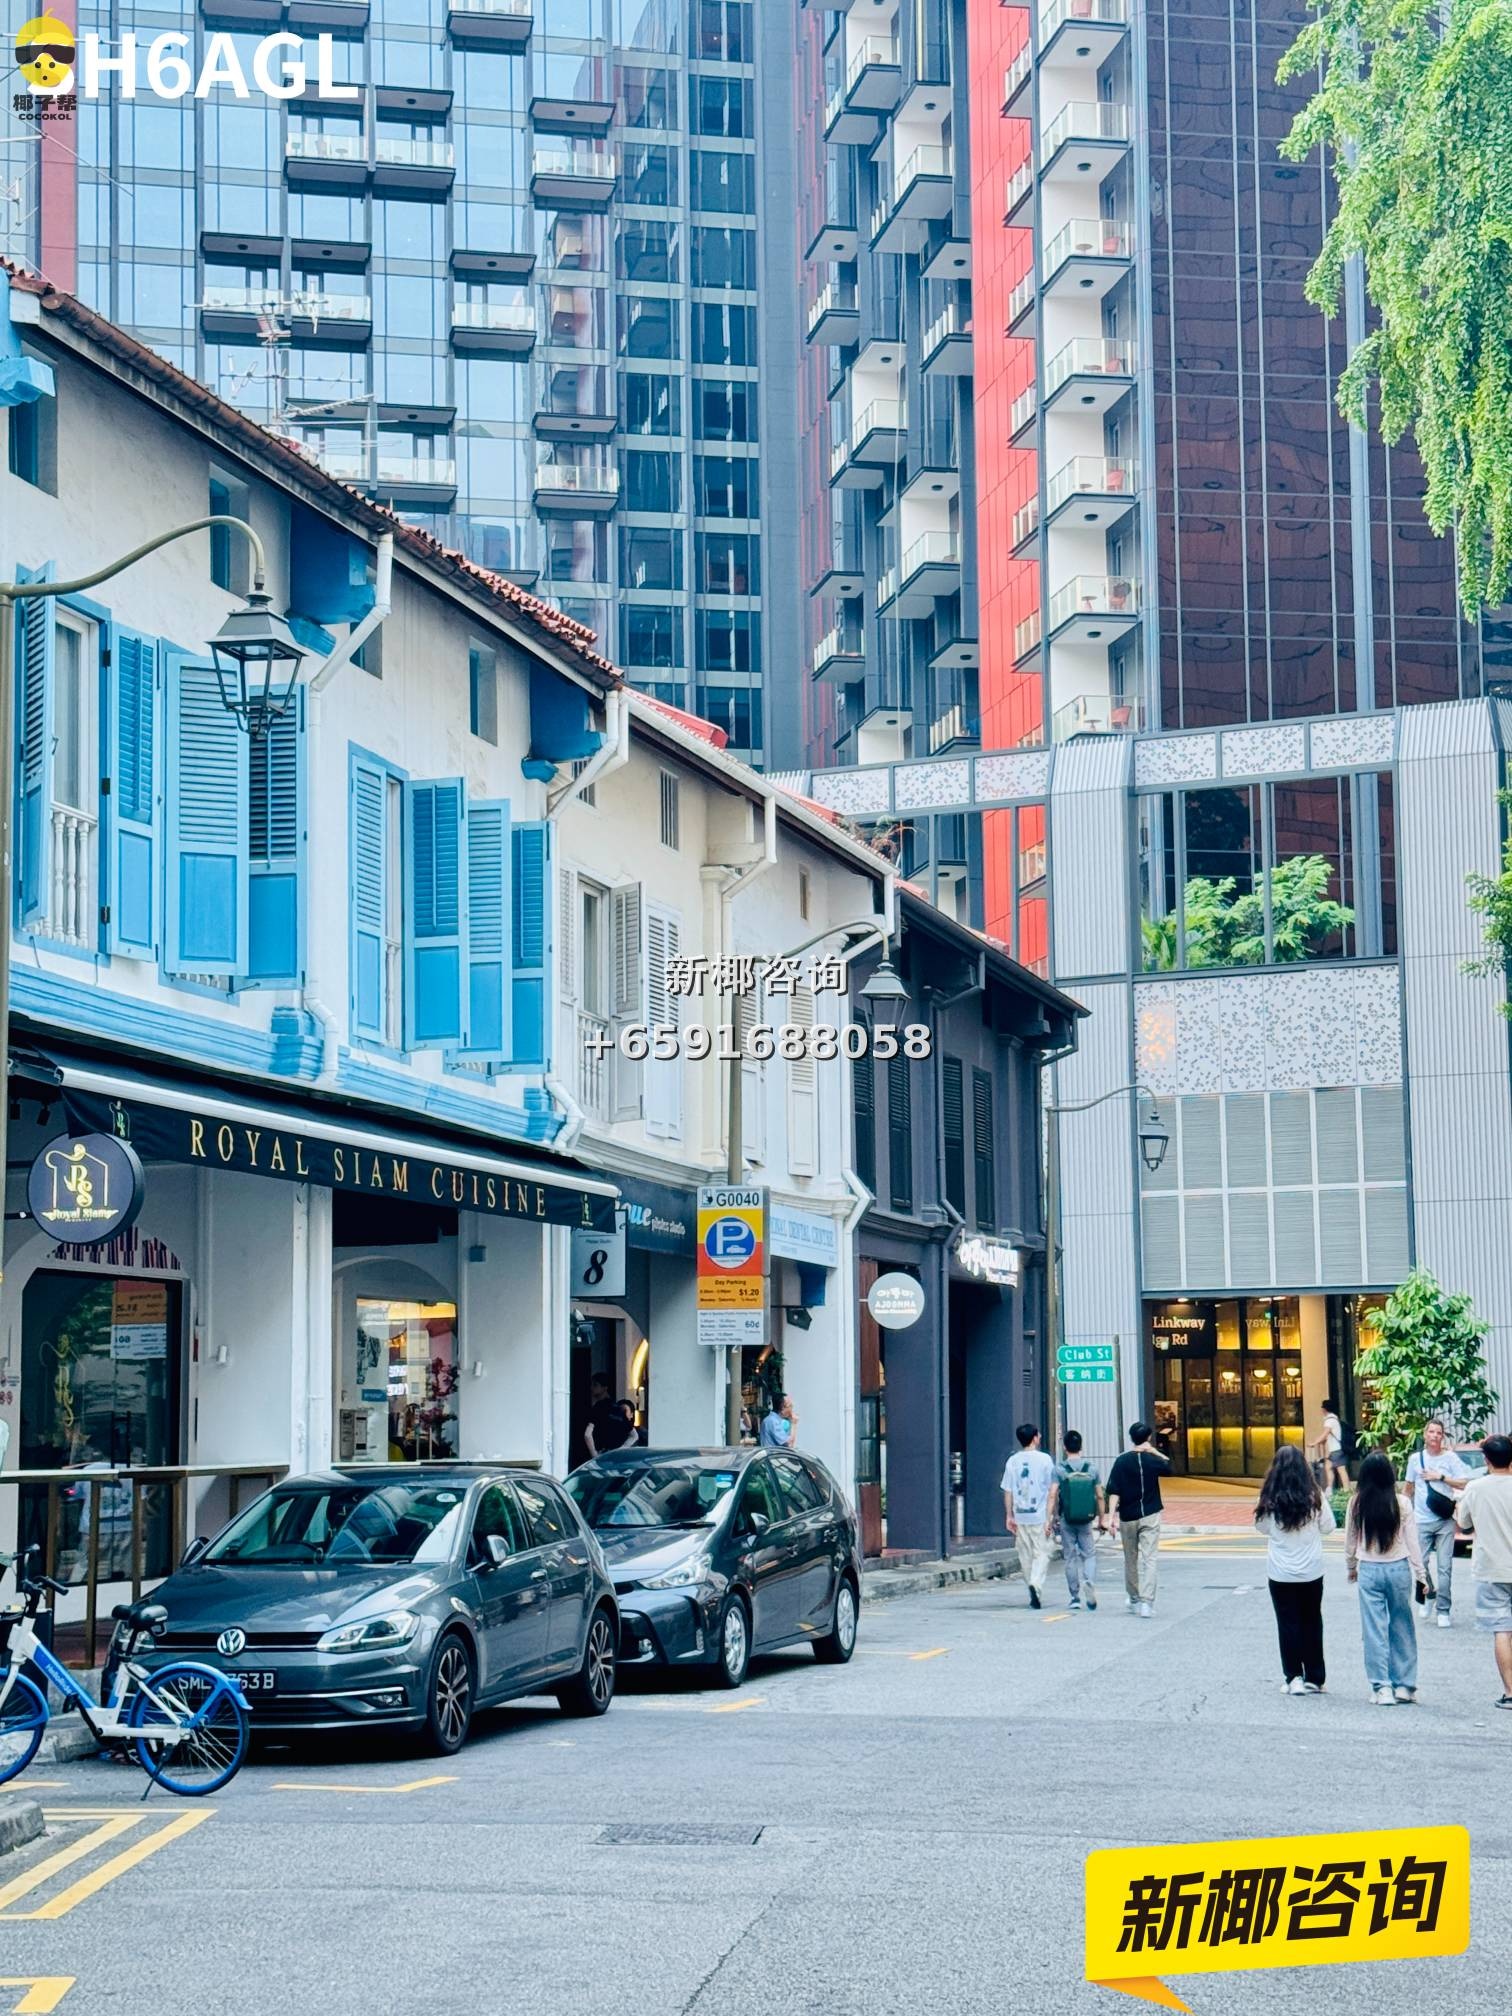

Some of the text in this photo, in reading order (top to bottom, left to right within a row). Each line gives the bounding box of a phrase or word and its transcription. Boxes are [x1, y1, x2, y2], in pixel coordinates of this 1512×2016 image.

[189, 1119, 310, 1175] ROYAL
[334, 1148, 409, 1193] SIAM
[431, 1167, 546, 1217] CUISINE
[716, 1192, 760, 1207] G0040
[716, 1221, 750, 1255] P
[583, 1249, 608, 1285] 8
[738, 1288, 760, 1297] $1.20
[1153, 1316, 1206, 1330] Linkway
[1171, 1333, 1189, 1346] Rd
[1064, 1347, 1110, 1361] Club St
